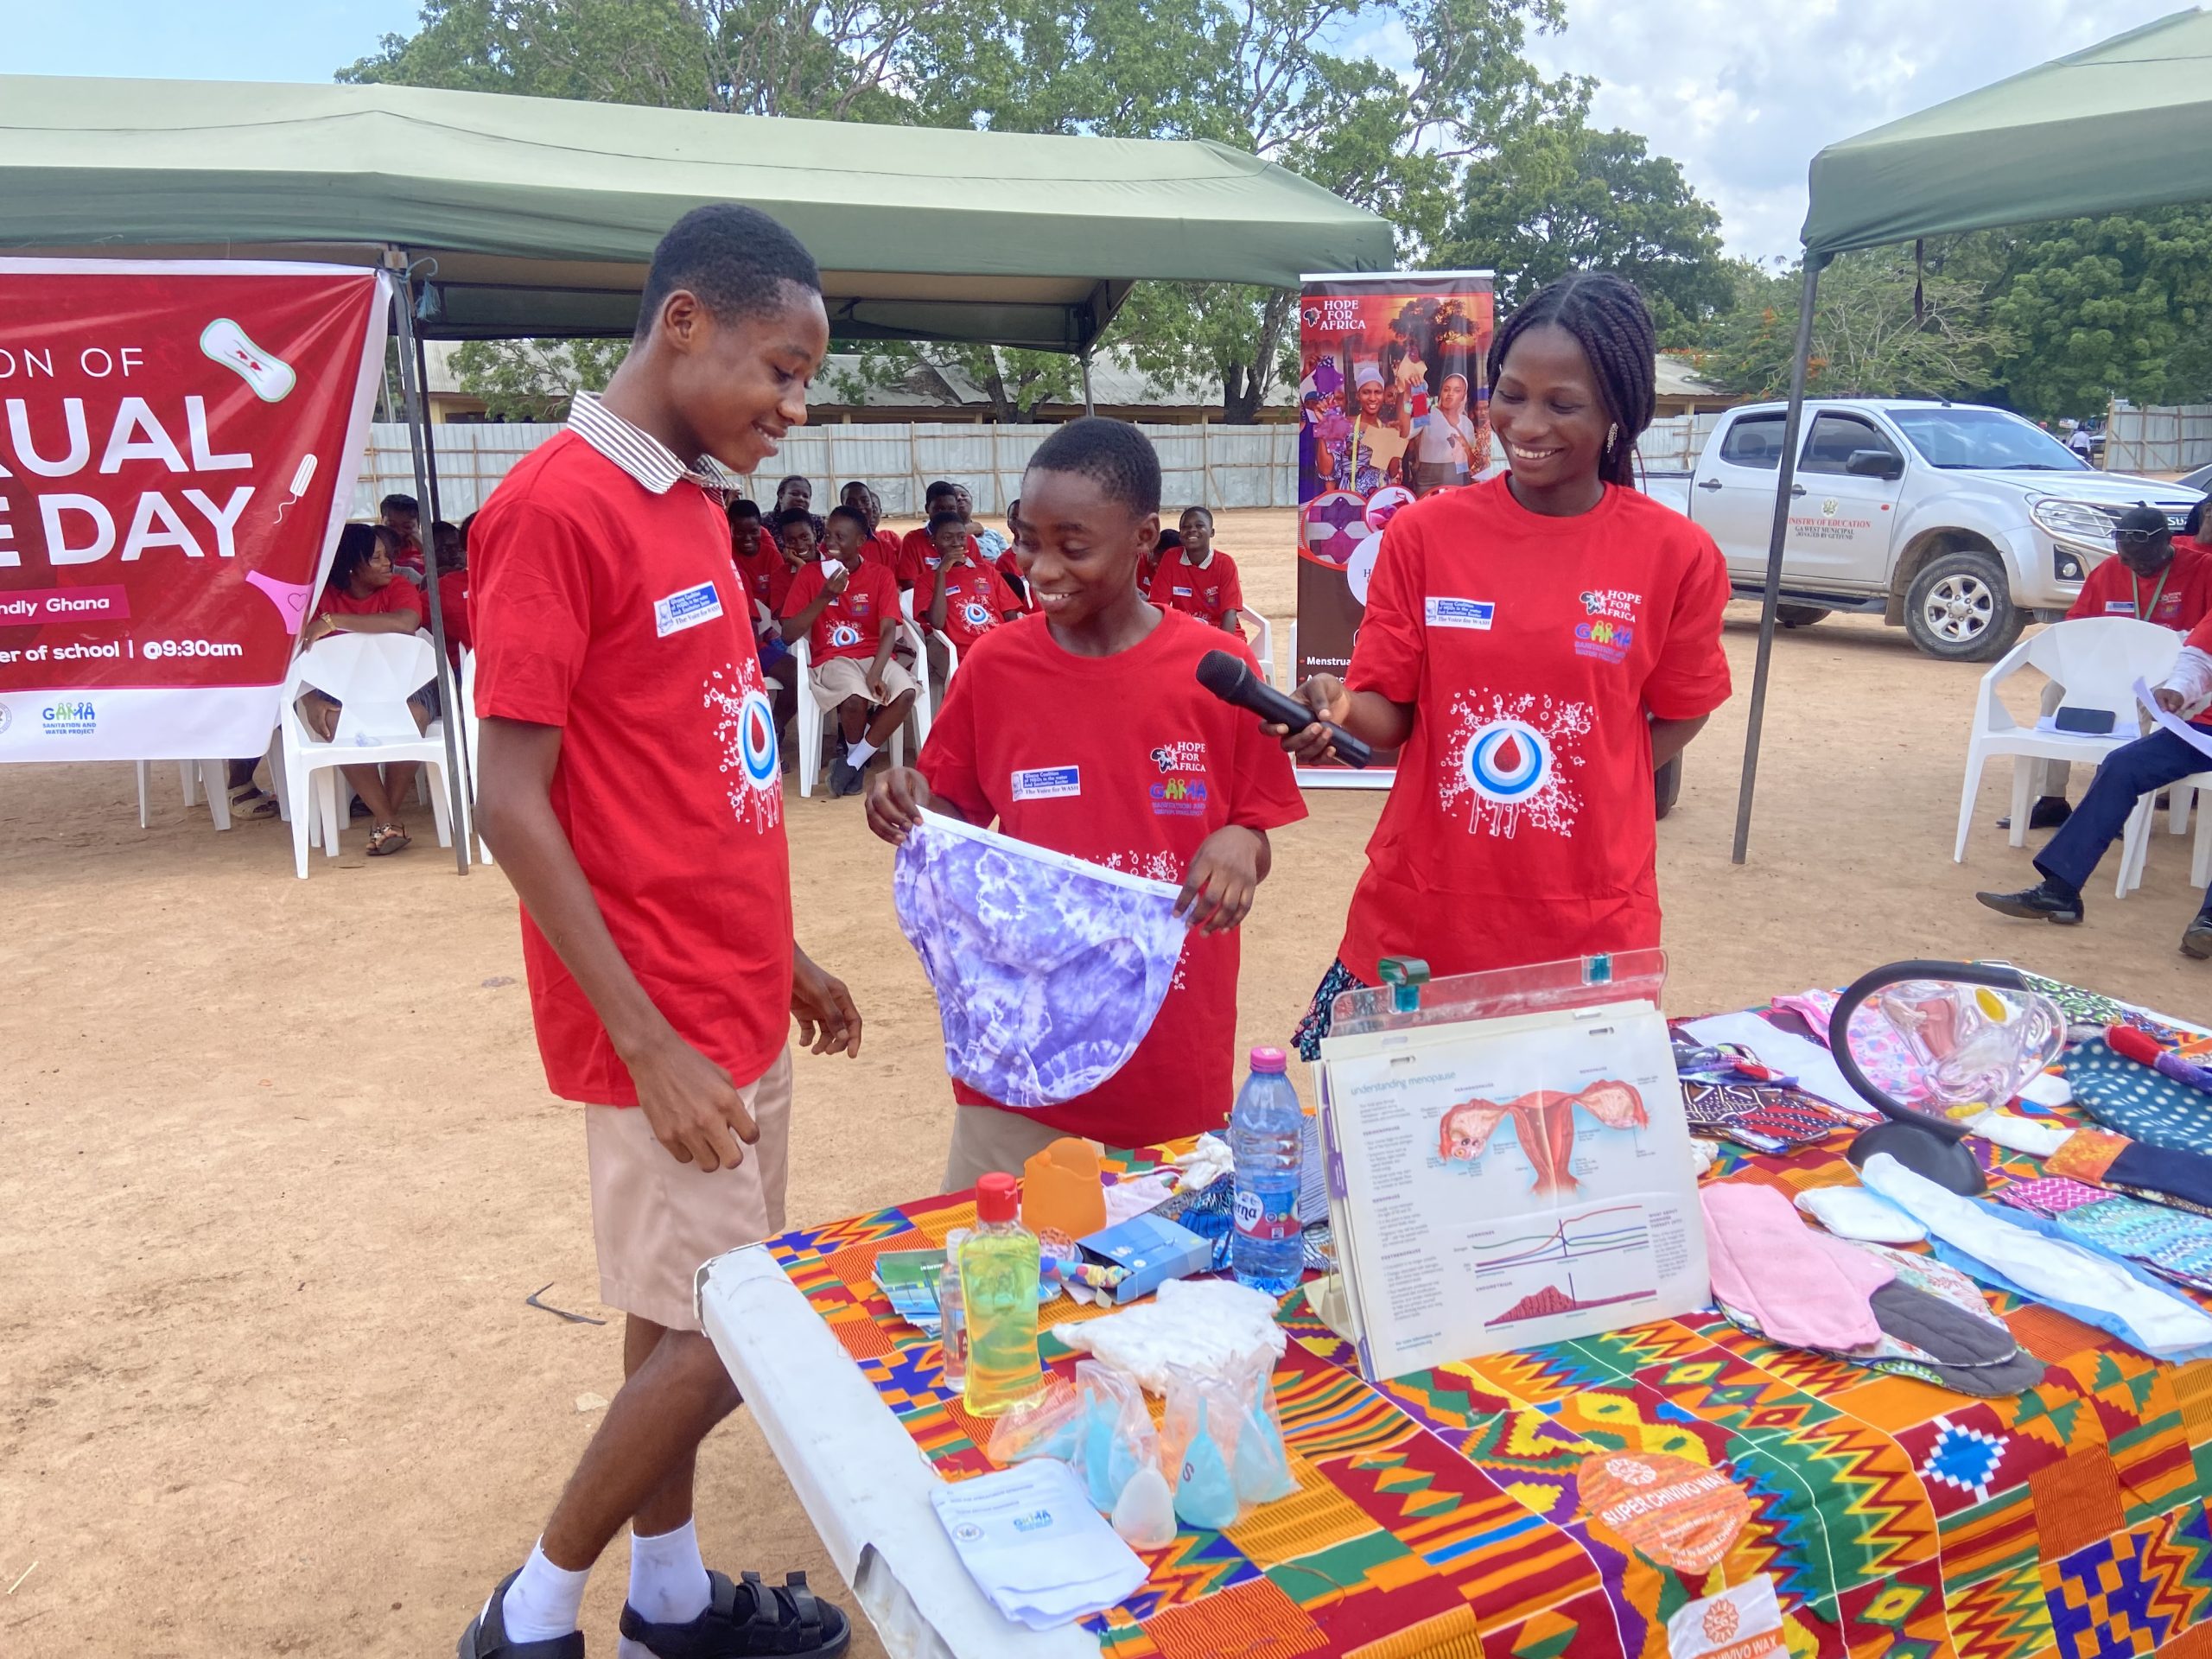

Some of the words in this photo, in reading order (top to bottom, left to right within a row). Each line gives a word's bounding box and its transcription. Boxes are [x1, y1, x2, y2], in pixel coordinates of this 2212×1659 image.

[1324, 300, 1359, 310] HOPE
[1327, 310, 1353, 321] FOR
[1319, 319, 1367, 330] AFRICA
[80, 347, 144, 378] OF
[0, 396, 253, 477] UAL
[38, 486, 256, 566] DAY
[1608, 589, 1643, 605] HOPE
[0, 600, 38, 617] ndly
[46, 597, 111, 613] Ghana
[1610, 600, 1631, 612] FOR
[1599, 607, 1637, 623] AFRICA
[26, 645, 48, 663] of
[53, 641, 120, 660] school
[143, 639, 243, 659] @9:30am
[42, 702, 96, 721] GAMA
[1177, 741, 1206, 753] HOPE
[1181, 753, 1200, 762] FOR
[1172, 762, 1207, 772] AFRICA
[1350, 1077, 1408, 1096] understanding
[1408, 1071, 1457, 1085] menopause
[1601, 1496, 1650, 1526] SUPER
[1694, 1472, 1729, 1491] WAX
[1751, 1634, 1778, 1656] WAX
